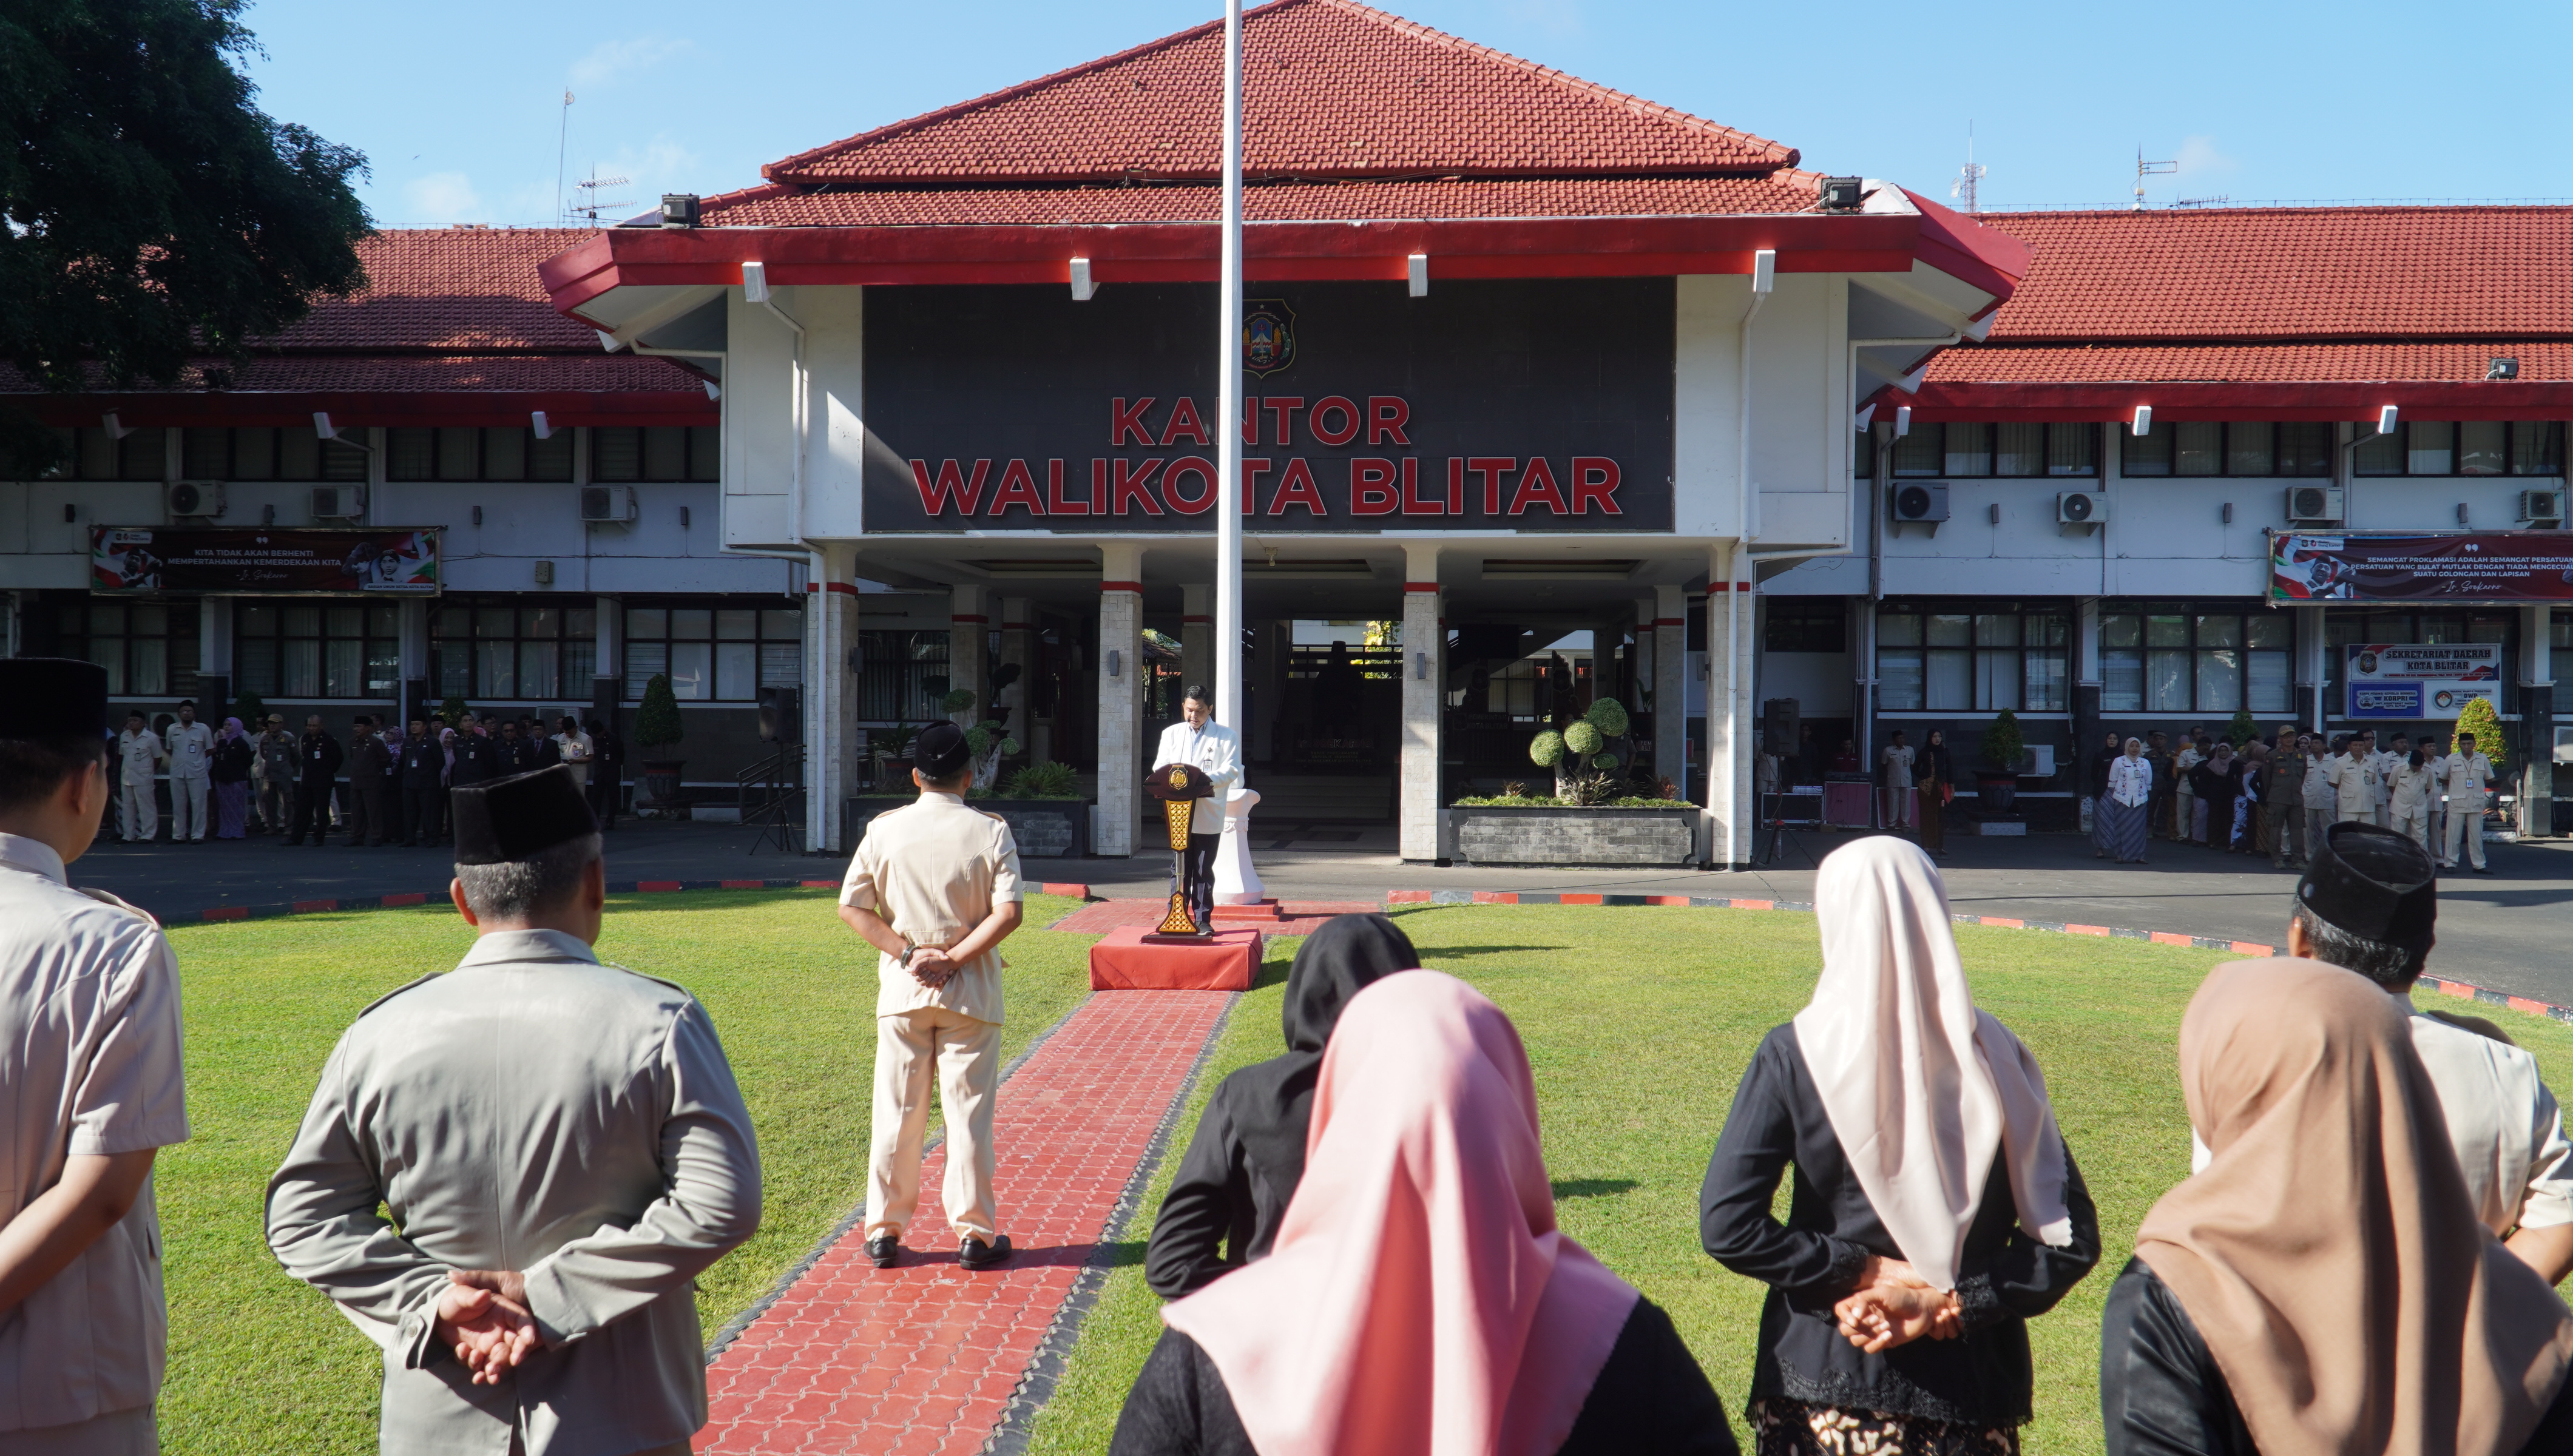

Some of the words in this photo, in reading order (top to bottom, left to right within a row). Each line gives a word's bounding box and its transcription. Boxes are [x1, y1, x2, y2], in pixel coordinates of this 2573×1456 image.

[1112, 396, 1410, 446] KANTOR
[910, 456, 1327, 515] WALIKOTA
[1350, 456, 1622, 515] BLITAR
[2461, 581, 2502, 593] Soekarno
[2386, 650, 2450, 658] SEKRETARIAT
[2452, 650, 2491, 658] DAERAH
[2407, 661, 2432, 670] KOTA
[2435, 661, 2469, 670] BLITAR
